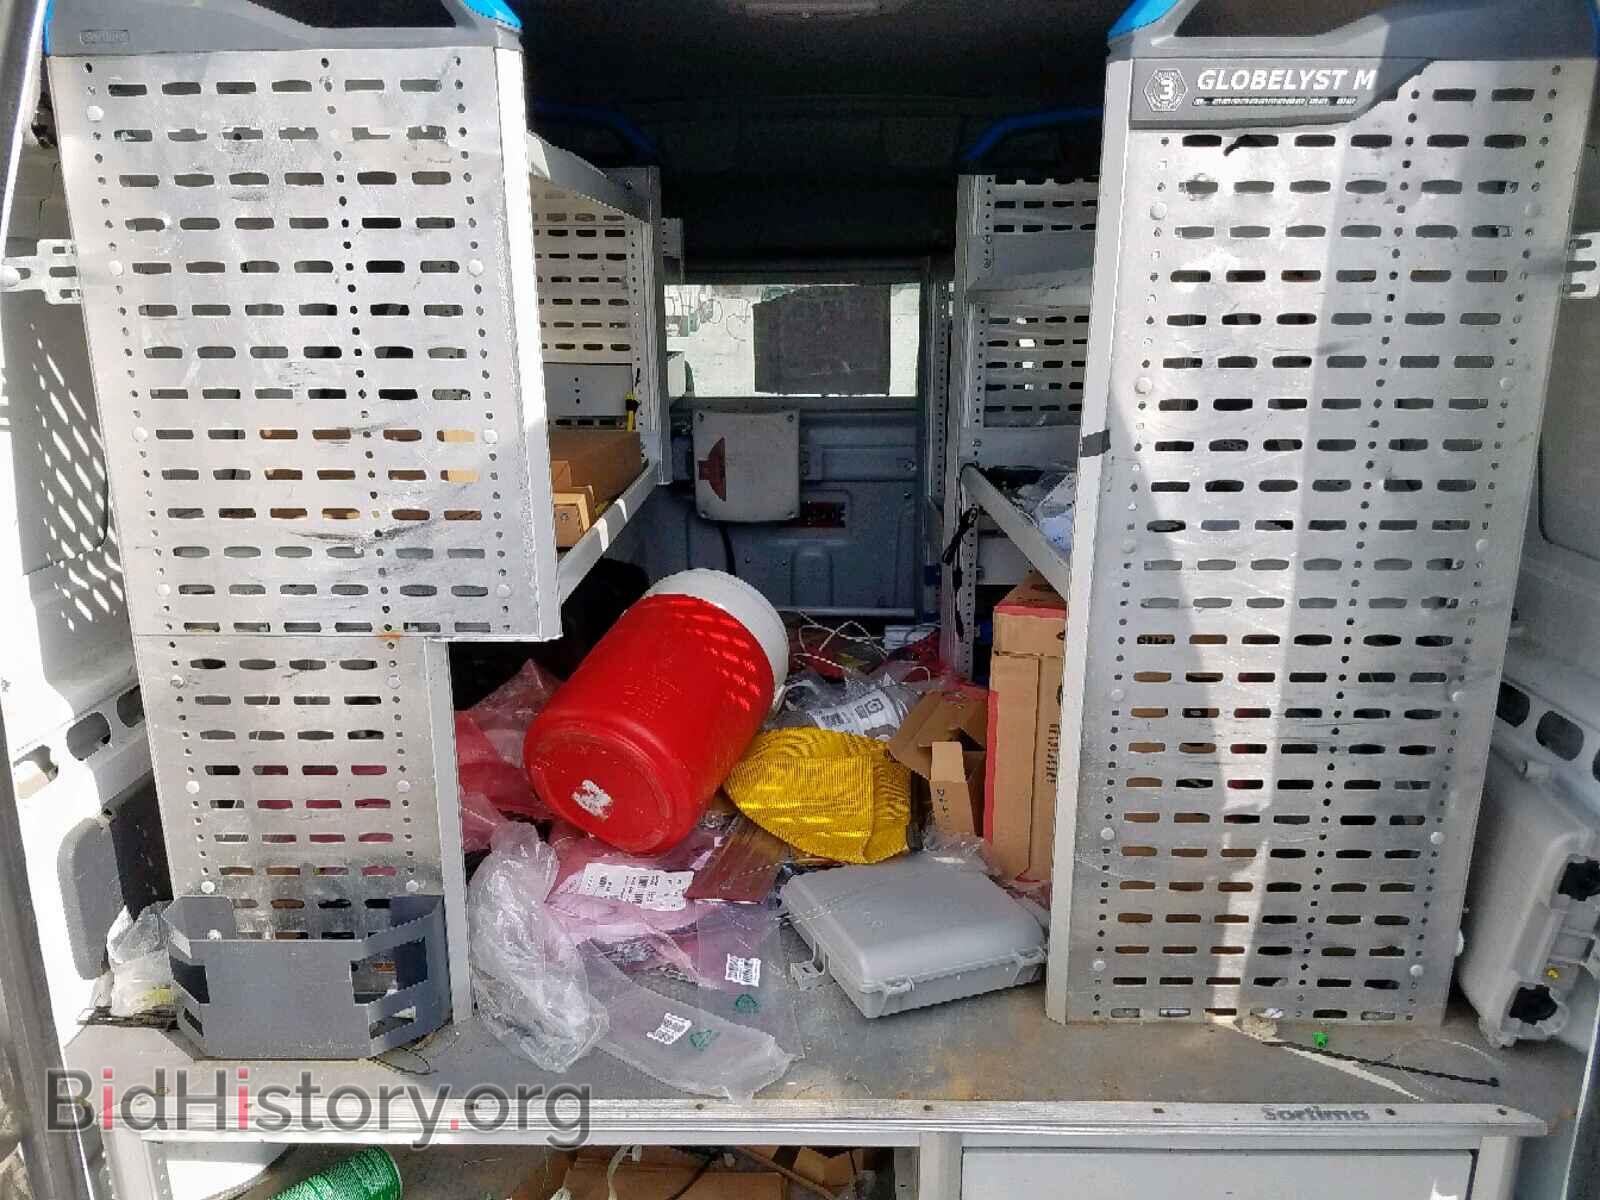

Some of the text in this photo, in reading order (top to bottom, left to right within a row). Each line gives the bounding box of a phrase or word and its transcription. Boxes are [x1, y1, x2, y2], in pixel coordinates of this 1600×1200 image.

[1159, 79, 1174, 101] 3
[1197, 69, 1348, 90] GLOBELYST
[1353, 69, 1377, 90] M
